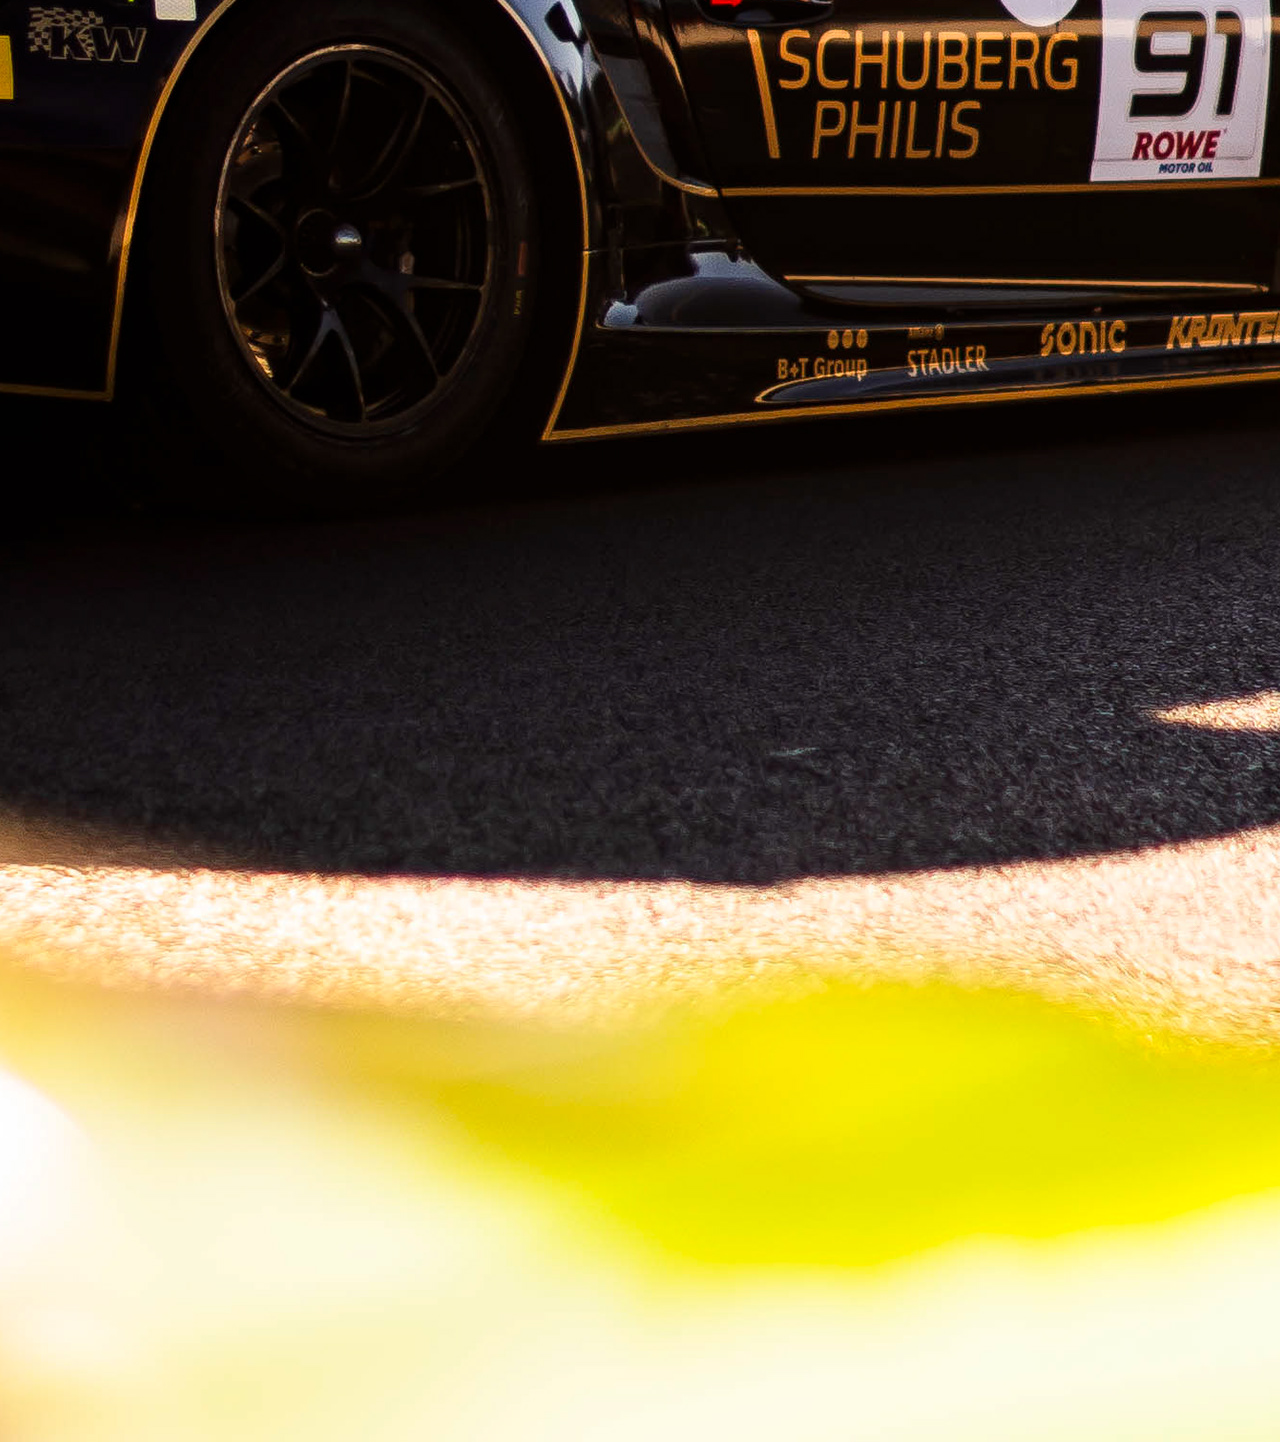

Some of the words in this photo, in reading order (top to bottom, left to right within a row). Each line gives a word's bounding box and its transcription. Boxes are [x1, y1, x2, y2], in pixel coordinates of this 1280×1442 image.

[49, 25, 148, 63] KW
[778, 29, 1078, 91] SCHUBERG
[1129, 10, 1243, 117] 91
[812, 100, 981, 159] PHILIS
[1132, 130, 1221, 161] ROWE
[1159, 163, 1195, 174] MOTOR
[1197, 162, 1213, 173] OIL
[777, 357, 808, 380] B+T
[813, 357, 868, 381] Group
[907, 345, 989, 377] STADLER
